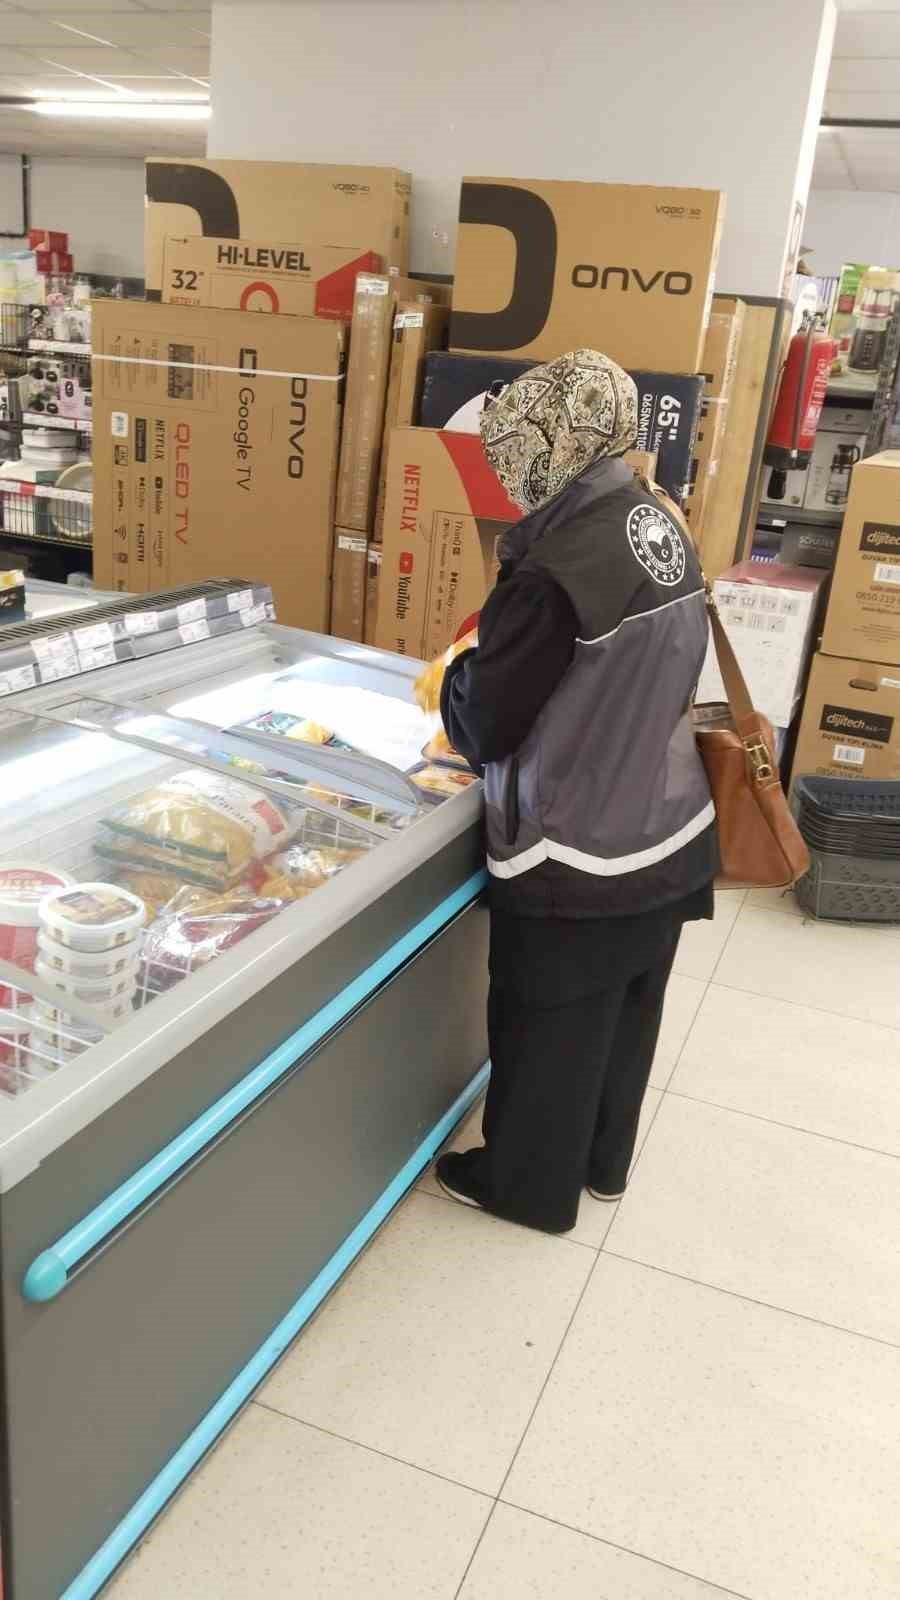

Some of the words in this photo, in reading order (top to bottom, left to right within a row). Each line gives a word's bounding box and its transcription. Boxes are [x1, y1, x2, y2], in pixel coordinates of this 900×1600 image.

[155, 419, 165, 460] NETFLIX
[234, 387, 254, 460] Google
[657, 394, 682, 441] 65"
[175, 423, 190, 498] QLED
[236, 467, 251, 491] TV
[400, 464, 421, 533] NETFLIX
[175, 511, 188, 545] TV
[396, 576, 411, 620] YouTube
